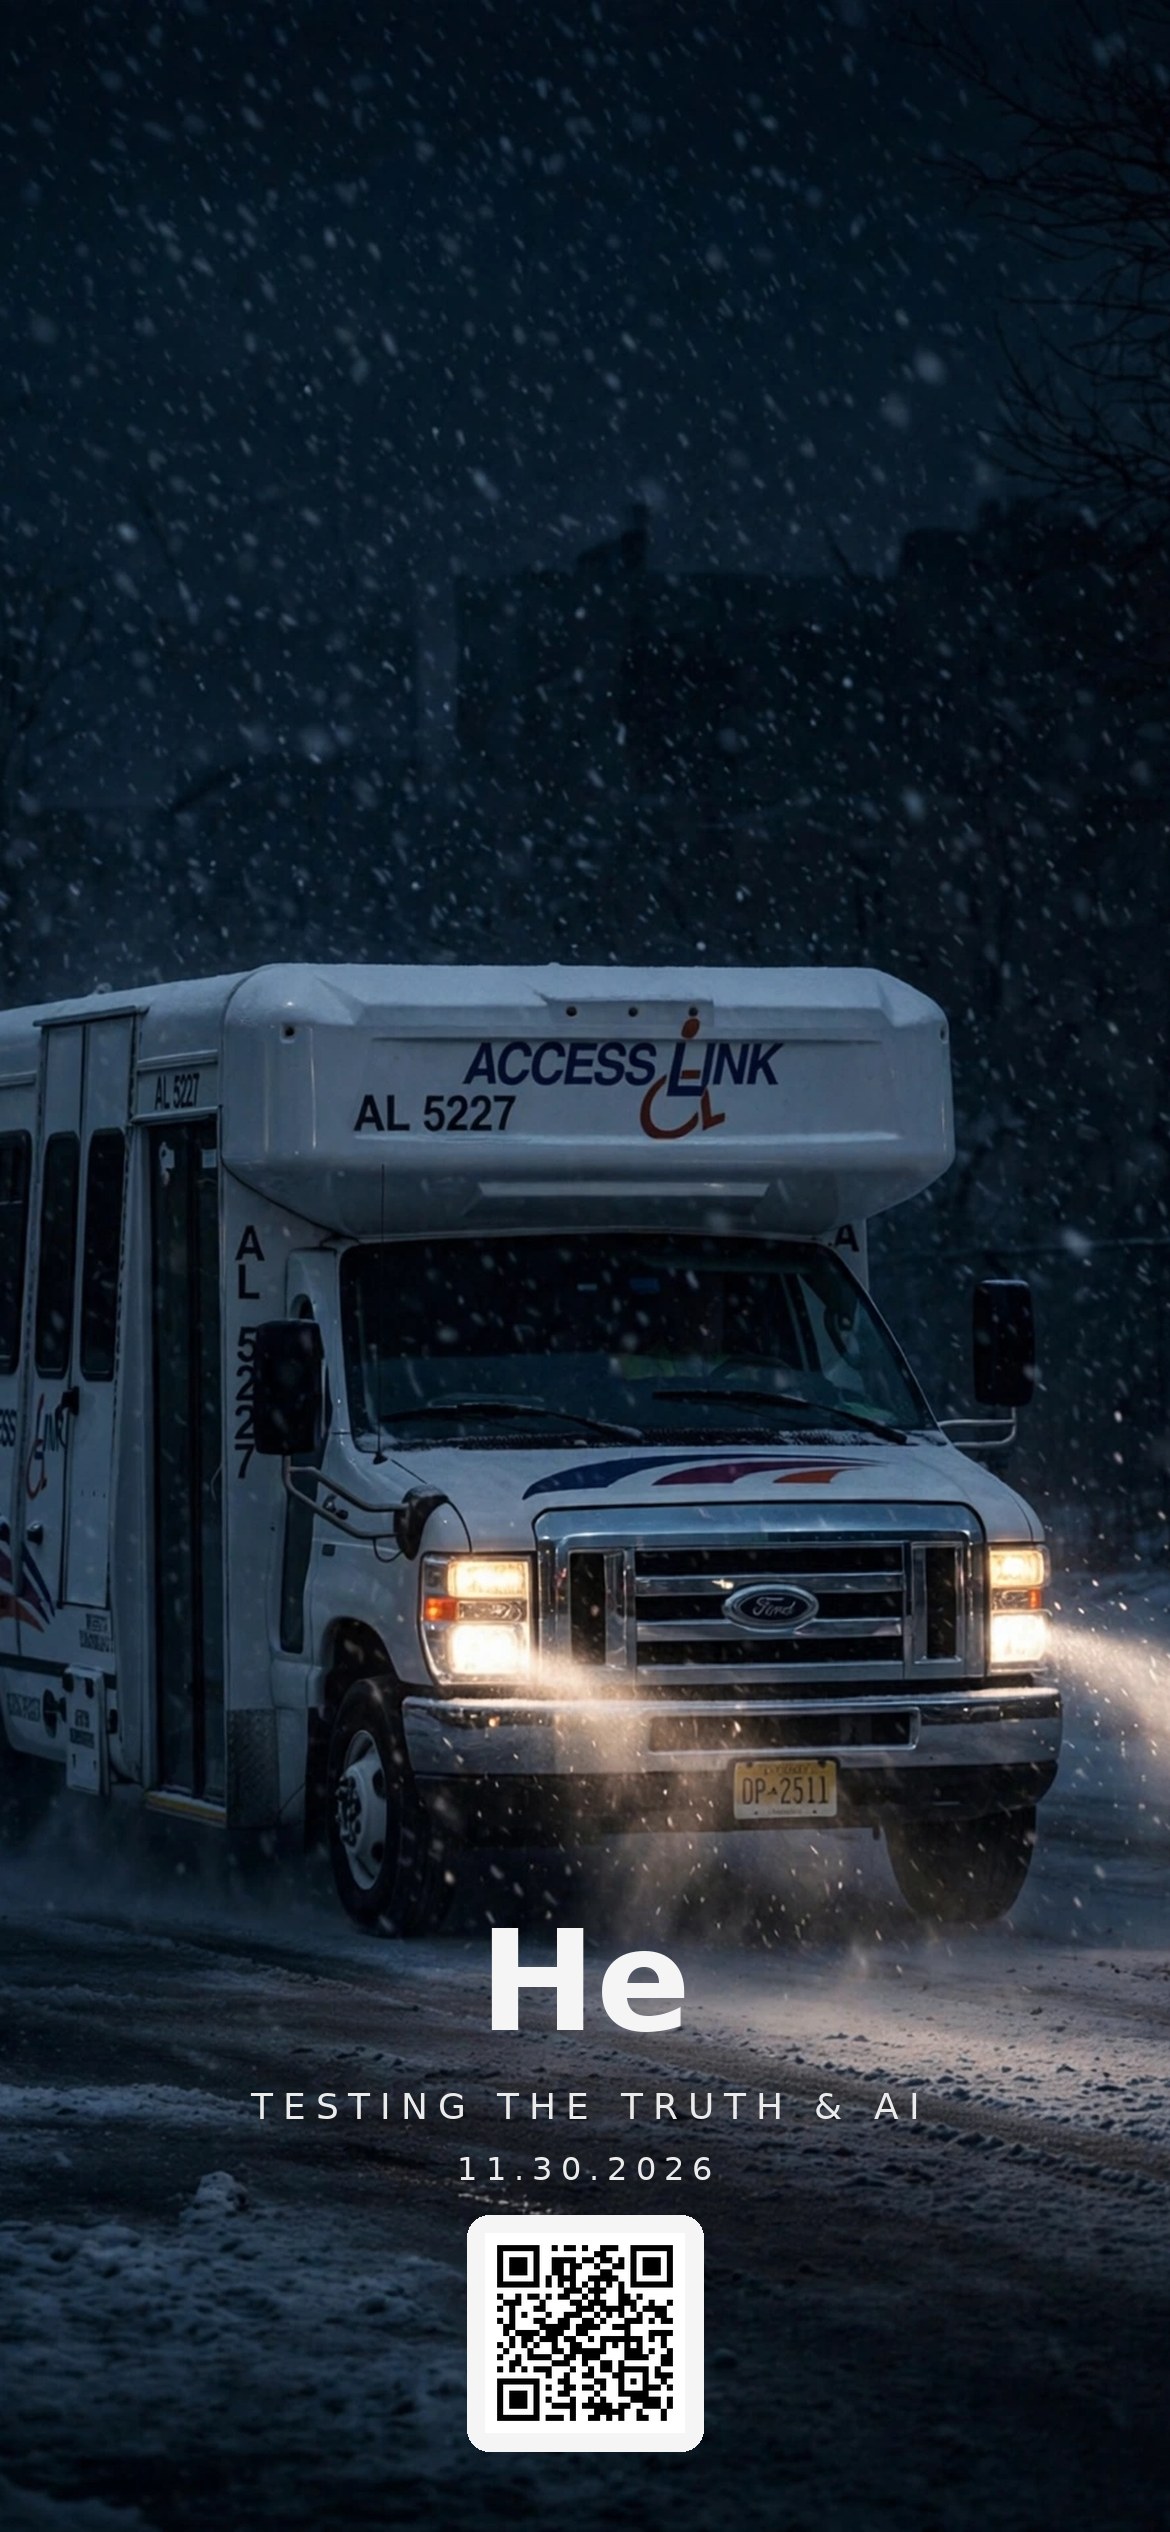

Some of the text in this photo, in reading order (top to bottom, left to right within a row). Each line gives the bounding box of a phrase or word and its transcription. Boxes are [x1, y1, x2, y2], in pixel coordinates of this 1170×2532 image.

[463, 1041, 783, 1097] ACCESS LINK
[154, 1073, 200, 1110] AL 5227
[354, 1095, 517, 1132] AL 5227
[835, 1224, 860, 1252] A
[752, 1596, 797, 1616] Ford
[779, 1775, 829, 1805] 2511
